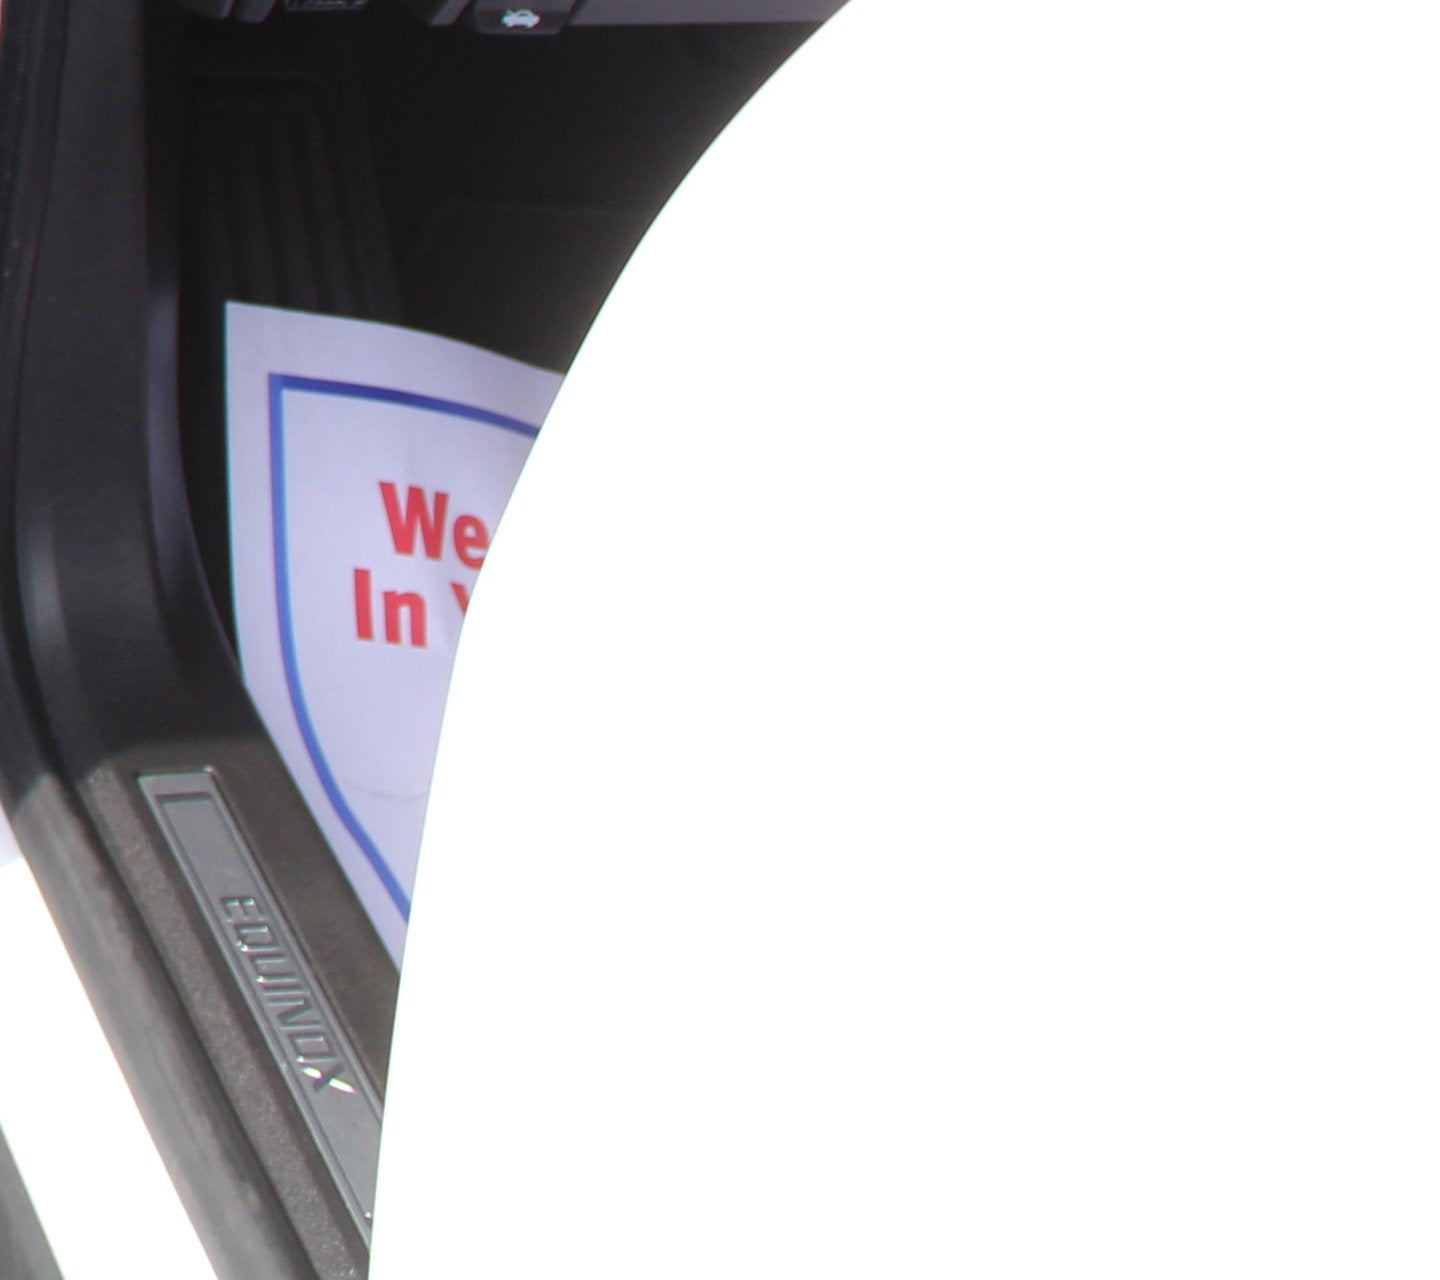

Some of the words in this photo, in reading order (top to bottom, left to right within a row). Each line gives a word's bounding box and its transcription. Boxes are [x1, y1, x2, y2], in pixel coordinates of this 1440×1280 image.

[379, 480, 490, 570] We
[352, 568, 428, 648] In
[220, 895, 356, 1094] EQUINOX
